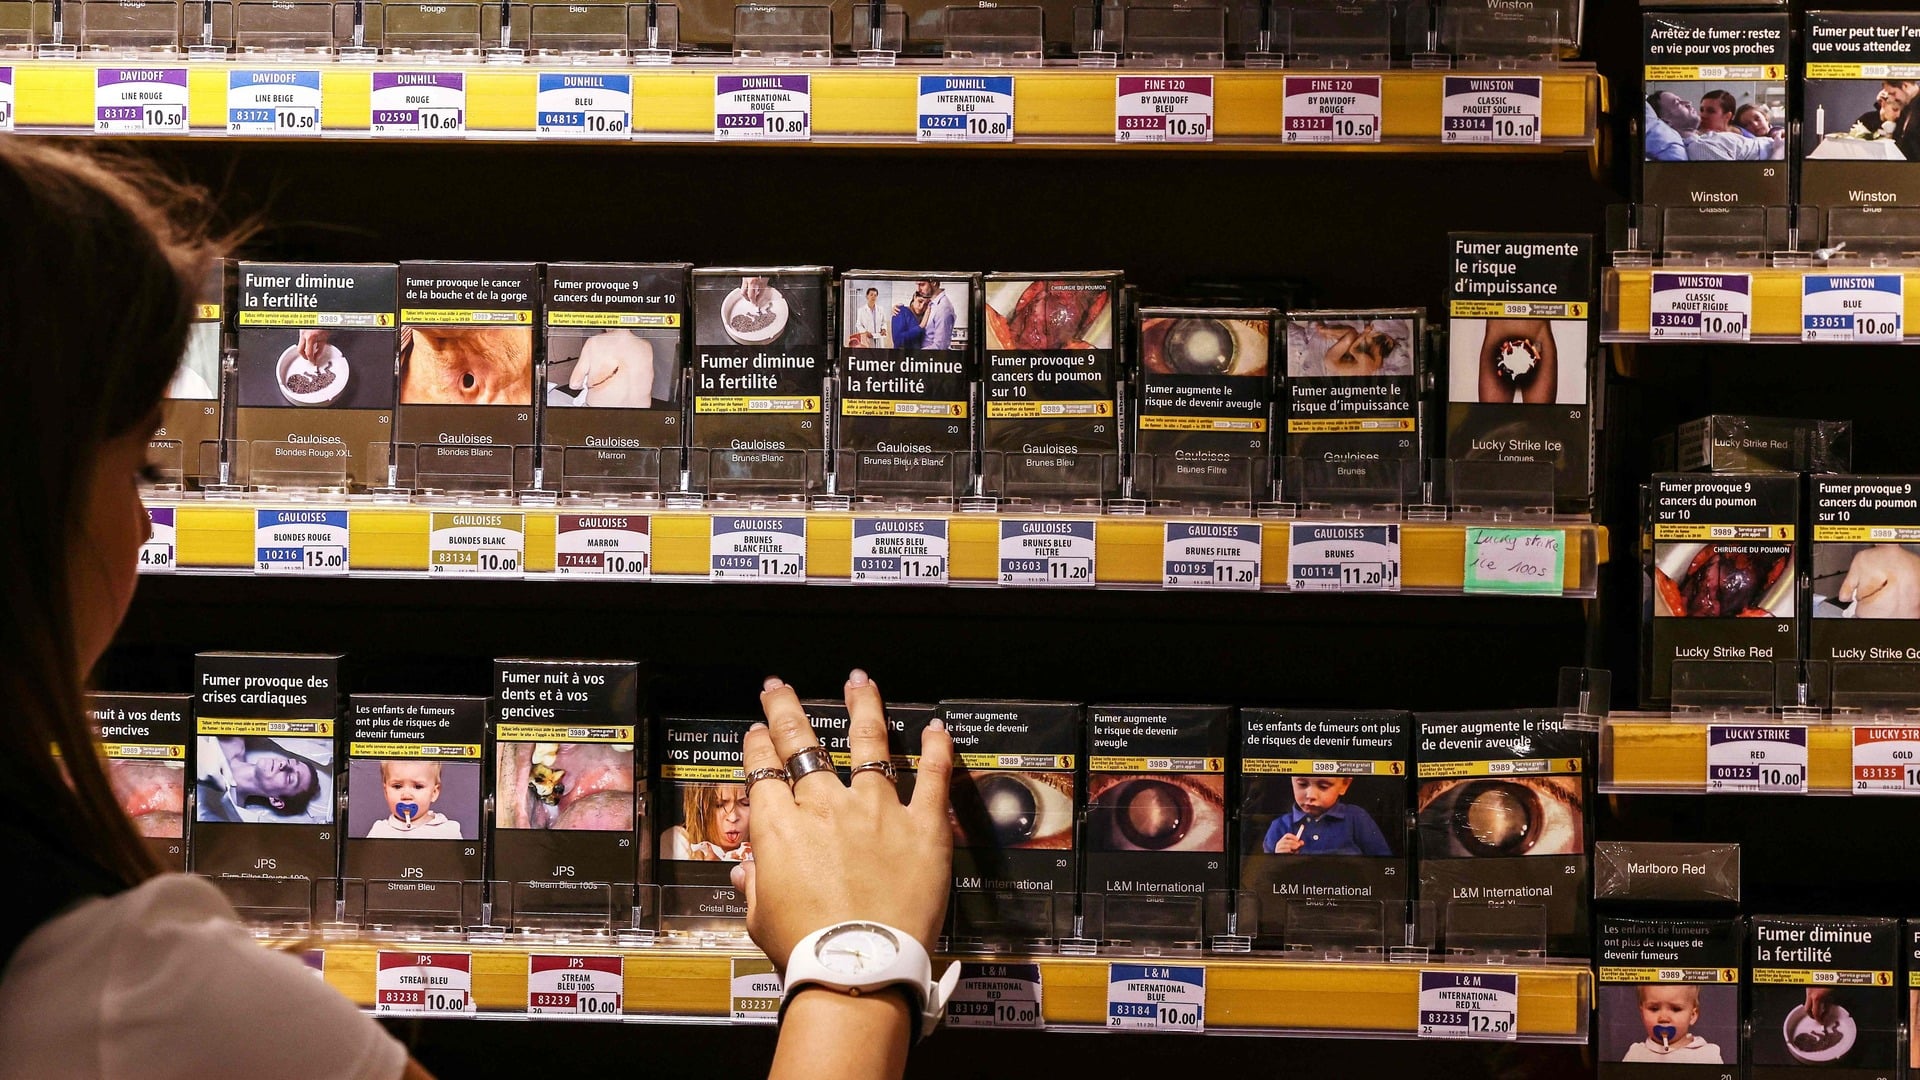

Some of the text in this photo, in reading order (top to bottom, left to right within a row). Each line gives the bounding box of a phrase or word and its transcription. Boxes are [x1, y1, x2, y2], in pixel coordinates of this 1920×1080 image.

[1651, 26, 1692, 39] Arrêtez
[1692, 28, 1706, 39] de
[1708, 27, 1741, 39] fumer
[1748, 29, 1780, 39] restez
[1651, 42, 1775, 56] en vie pour vos proches
[120, 71, 164, 82] DAVIDOFF
[946, 79, 986, 89] DUNHILL
[1145, 80, 1185, 90] FINE 120
[1470, 80, 1514, 90] WINSTON
[121, 92, 163, 100] LINE ROUGE
[937, 95, 994, 103] INTERNATIONAL
[1141, 96, 1188, 104] BY DAVIDOFF
[1477, 97, 1507, 105] CLASSIC
[957, 104, 975, 112] BLEU
[1155, 105, 1174, 113] BLEU
[1463, 105, 1521, 114] PAQUET SOUPLE
[105, 109, 136, 118] 83173
[146, 110, 181, 125] 10.50
[927, 117, 959, 127] 02671
[969, 118, 1005, 134] 10.80
[1126, 118, 1158, 128] 83122
[1168, 119, 1205, 135] 10.50
[1452, 119, 1485, 129] 33014
[1495, 120, 1532, 136] 10.10
[1764, 168, 1775, 176] 20
[1691, 191, 1738, 202] Winston
[1456, 240, 1578, 259] Fumer augmente
[1456, 258, 1516, 277] le risque
[246, 273, 354, 288] Fumer diminue
[554, 279, 638, 292] Fumer provoque 9
[1830, 278, 1874, 288] WINSTON
[245, 292, 318, 308] la fertilité
[553, 294, 588, 302] cancers
[591, 293, 602, 302] du
[605, 295, 643, 305] poumon
[664, 294, 675, 304] 10
[1843, 300, 1862, 308] BLUE
[1507, 305, 1526, 314] 3989
[1812, 317, 1845, 327] 33051
[1856, 318, 1894, 334] 10.00
[1570, 410, 1581, 419] 20
[287, 433, 341, 444] Gauloises
[585, 437, 640, 447] Gauloises
[1714, 437, 1787, 450] Lucky Strike Red
[1472, 439, 1562, 452] Lucky Strike Ice
[275, 448, 353, 458] Blondes Rouge XXL
[598, 450, 626, 459] Marron
[278, 512, 326, 522] GAULOISES
[579, 518, 627, 528] GAULOISES
[875, 522, 924, 532] GAULOISES
[274, 533, 331, 541] BLONDES ROUGE
[875, 538, 924, 546] BRUNES BLEU
[587, 539, 619, 547] MARRON
[265, 550, 297, 559] 10216
[871, 546, 928, 555] & BLANC FILTRE
[1761, 546, 1790, 554] POUMON
[306, 551, 341, 567] 15.00
[565, 555, 597, 565] 71444
[606, 557, 642, 573] 10.00
[861, 560, 893, 569] 03102
[903, 561, 939, 577] 11.20
[1676, 646, 1773, 659] Lucky Strike Red
[203, 673, 328, 690] Fumer provoque des
[202, 690, 307, 707] crises cardiaques
[356, 705, 455, 715] Les enfants de fumeurs
[356, 717, 450, 729] ont plus de risques de
[355, 729, 425, 739] devenir fumeurs
[1725, 729, 1790, 739] LUCKY STRIKE
[1750, 751, 1765, 759] RED
[1149, 760, 1168, 768] 3989
[1718, 767, 1752, 778] 00125
[1762, 769, 1799, 785] 10.00
[1207, 861, 1218, 869] 20
[1627, 863, 1706, 874] Marlboro Red
[401, 867, 423, 878] JPS
[418, 883, 435, 891] Bleu
[1107, 881, 1204, 893] L&M International
[1453, 885, 1553, 898] L&M International
[416, 955, 432, 965] JPS
[400, 976, 448, 985] STREAM BLEU
[752, 983, 781, 992] CRISTAL
[965, 981, 1023, 991] INTERNATIONAL
[386, 992, 418, 1002] 83238
[987, 990, 1001, 999] RED
[1439, 991, 1498, 1002] INTERNATIONAL
[427, 994, 463, 1012] 10.00
[740, 999, 773, 1010] 83237
[955, 1003, 988, 1013] 83199
[1455, 1001, 1480, 1009] RED XL
[997, 1005, 1033, 1022] 10.00
[1428, 1012, 1462, 1023] 83235
[1472, 1014, 1508, 1033] 12.50
